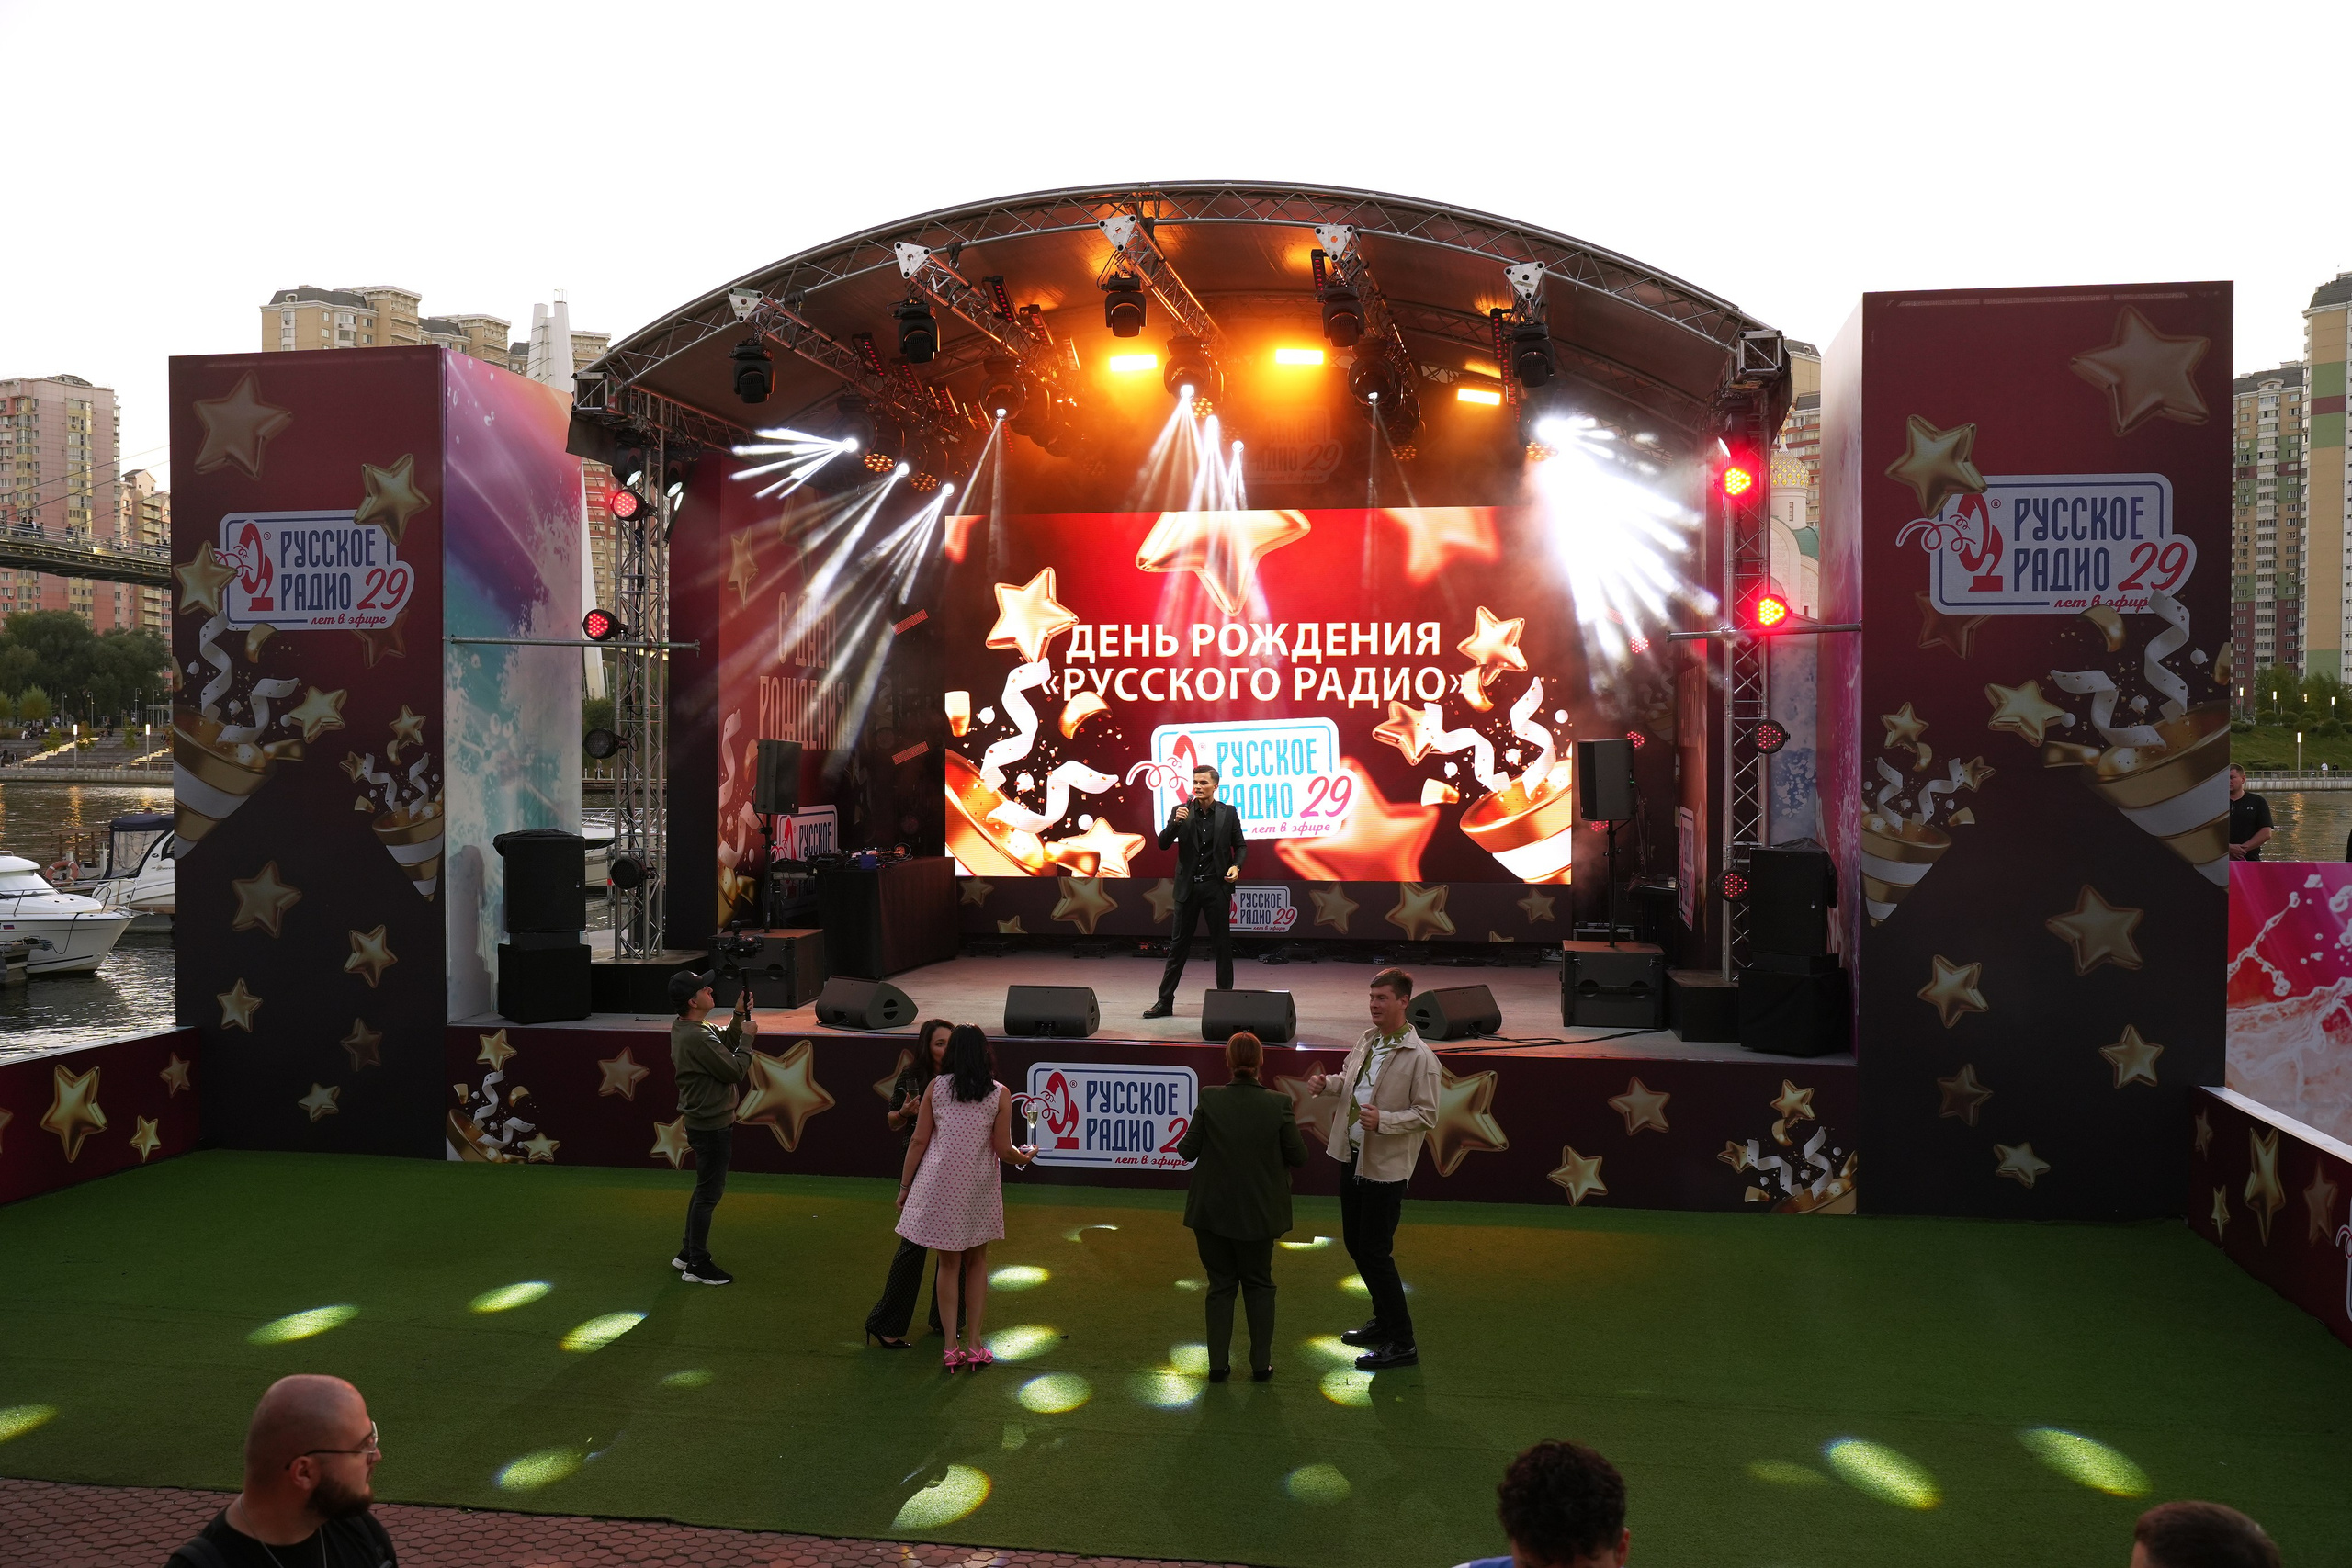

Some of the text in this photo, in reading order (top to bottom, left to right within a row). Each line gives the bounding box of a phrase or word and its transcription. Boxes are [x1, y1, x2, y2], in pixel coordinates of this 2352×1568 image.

[1302, 444, 1340, 472] 29
[2014, 496, 2144, 541] РУССКОЕ
[280, 529, 376, 568] РУССКОЕ
[2014, 542, 2188, 592] РАДИО 29
[281, 568, 409, 611] РАДИО 29
[2054, 594, 2150, 614] лет в эфир
[311, 613, 388, 627] лет в эфире
[778, 591, 788, 665] С
[1066, 622, 1441, 664] ДЕНЬ РОЖДЕНИЯ
[1216, 738, 1318, 778] РУССКОЕ
[1300, 775, 1353, 818] 29
[798, 822, 831, 859] РУССКОЕ
[1251, 822, 1330, 836] лет в эфире
[1240, 893, 1282, 908] РУССКОЕ
[1240, 908, 1295, 925] РАДИО 29
[1086, 1080, 1178, 1116] РУССКОЕ
[1086, 1117, 1189, 1154] РАДИО 2
[1114, 1155, 1190, 1169] лет в эфире
